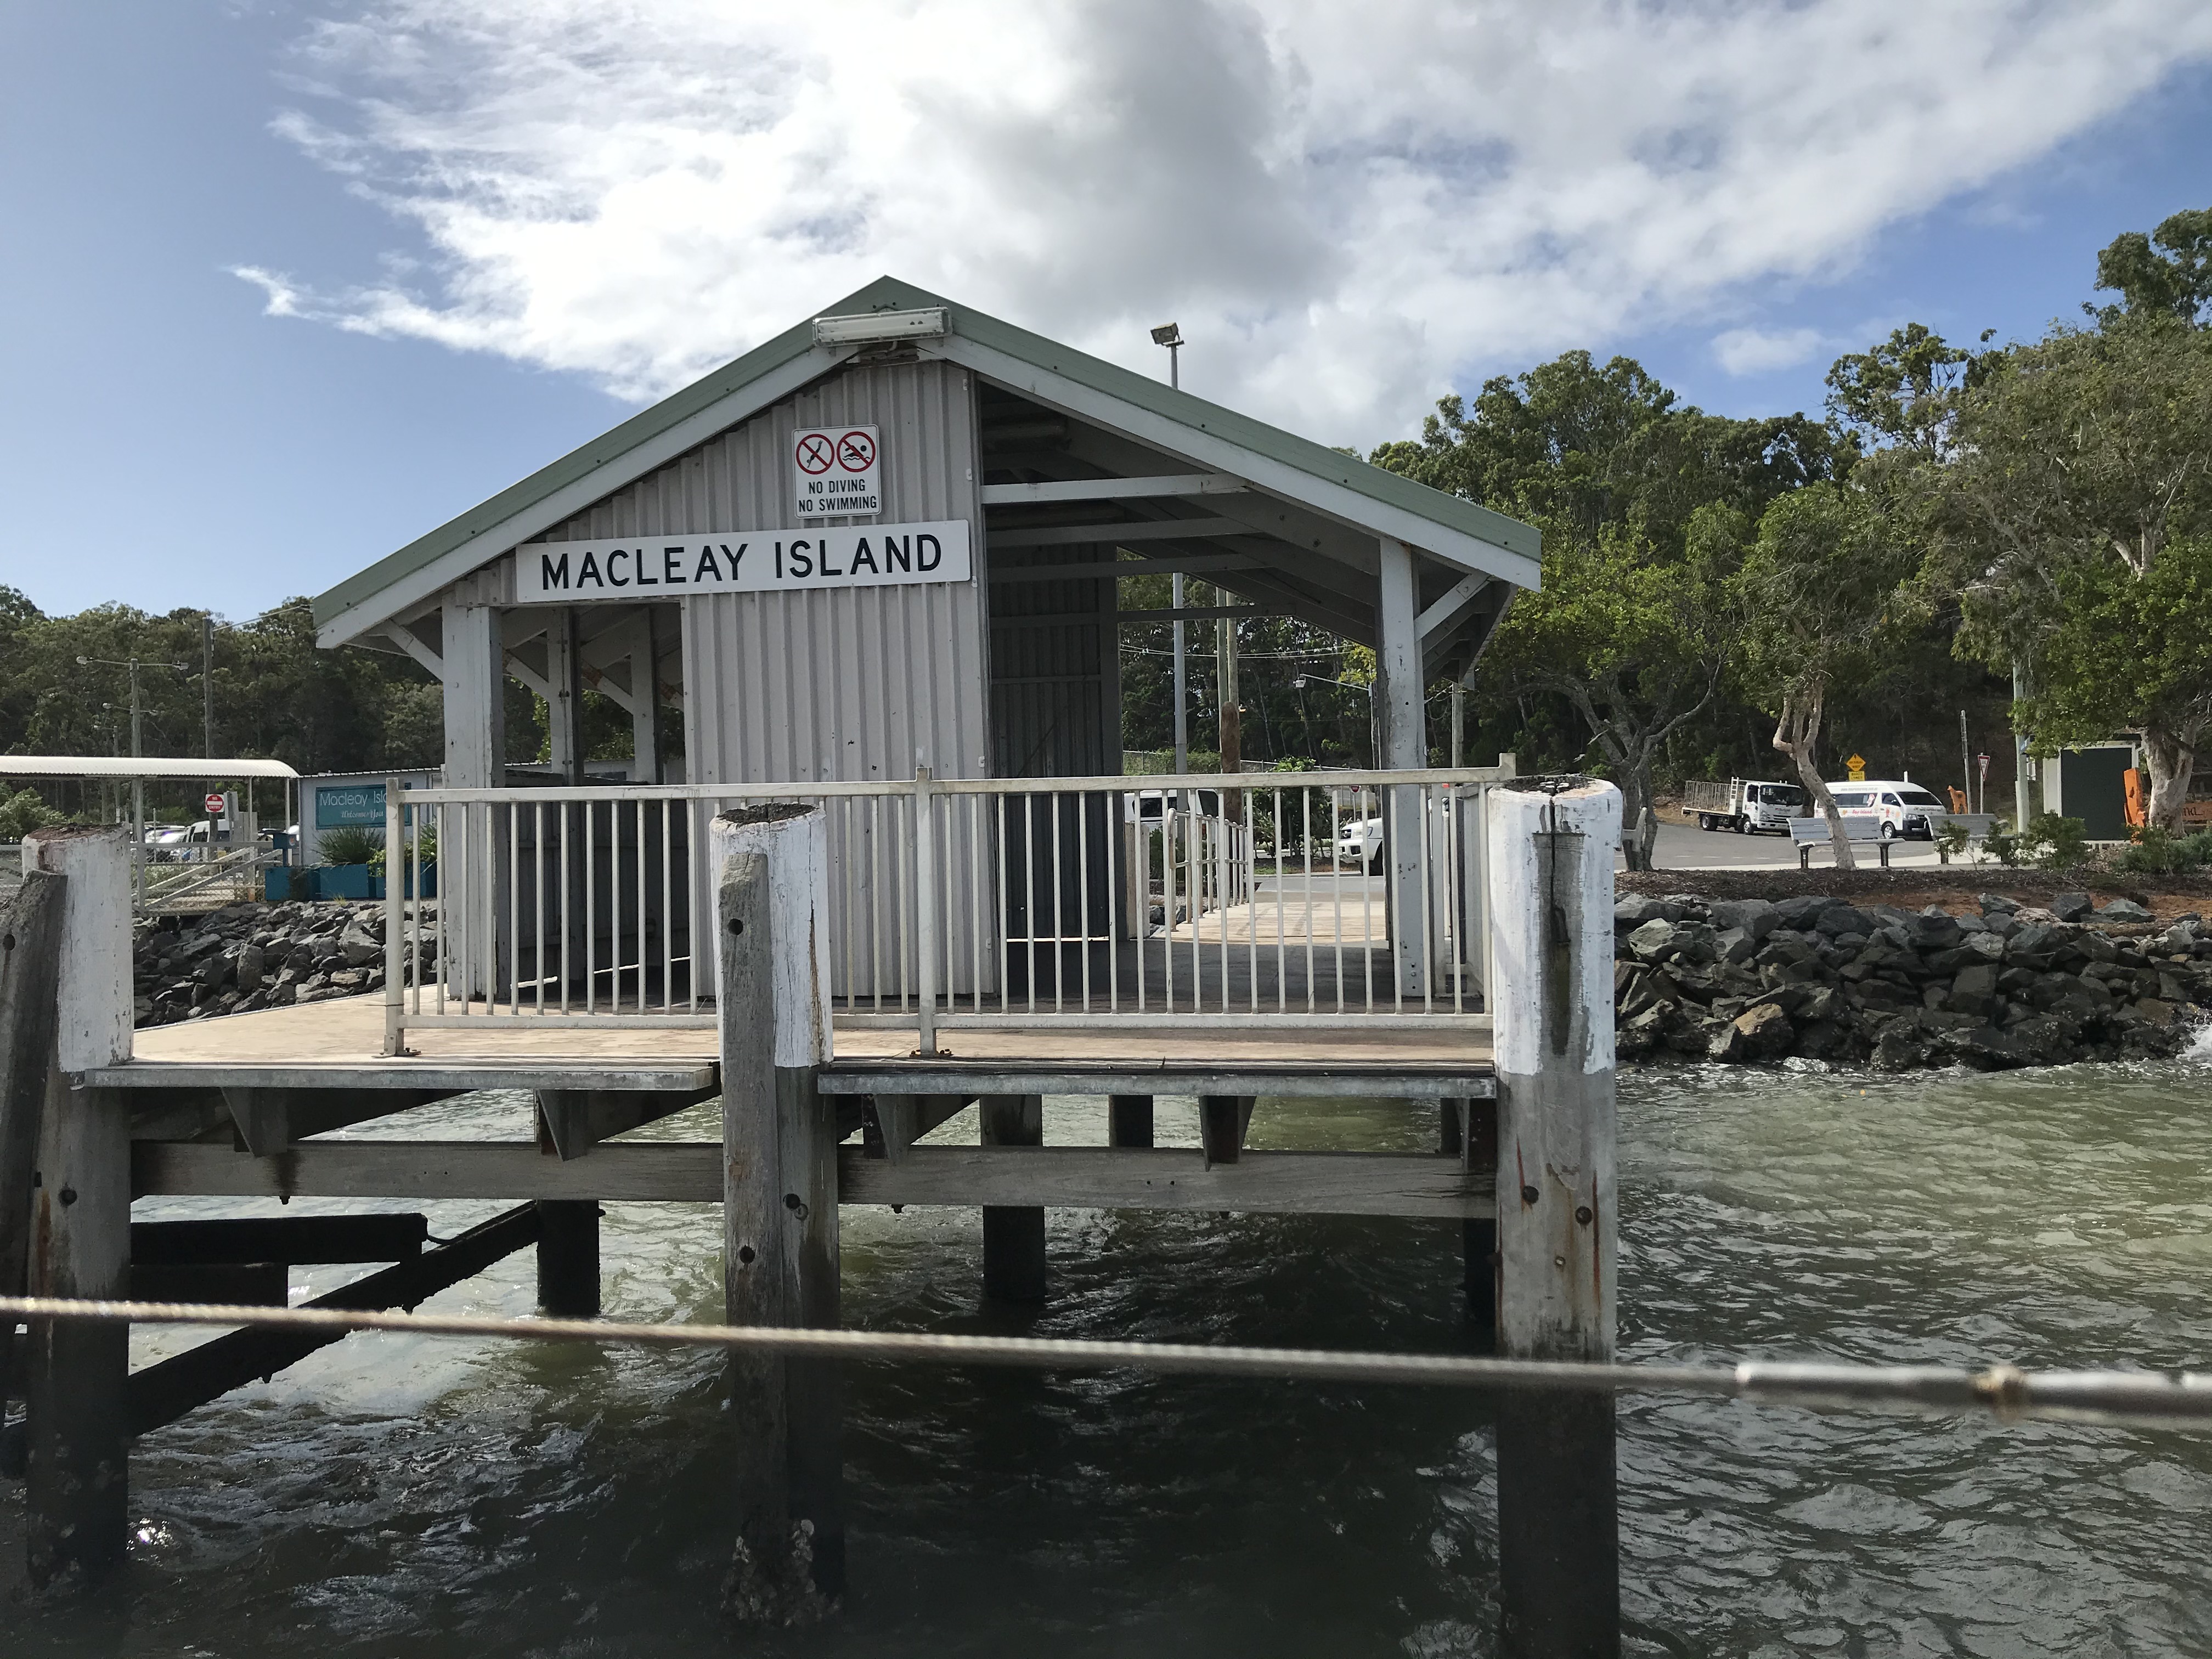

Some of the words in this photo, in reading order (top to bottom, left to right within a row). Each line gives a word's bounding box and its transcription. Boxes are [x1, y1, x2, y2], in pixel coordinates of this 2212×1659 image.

[809, 481, 823, 494] NO
[828, 479, 866, 493] DIVING
[799, 500, 813, 512] NO
[819, 496, 877, 511] SWIMMING
[542, 544, 748, 590] MACLEAY
[776, 534, 941, 578] ISLAND
[320, 792, 368, 807] Macleay
